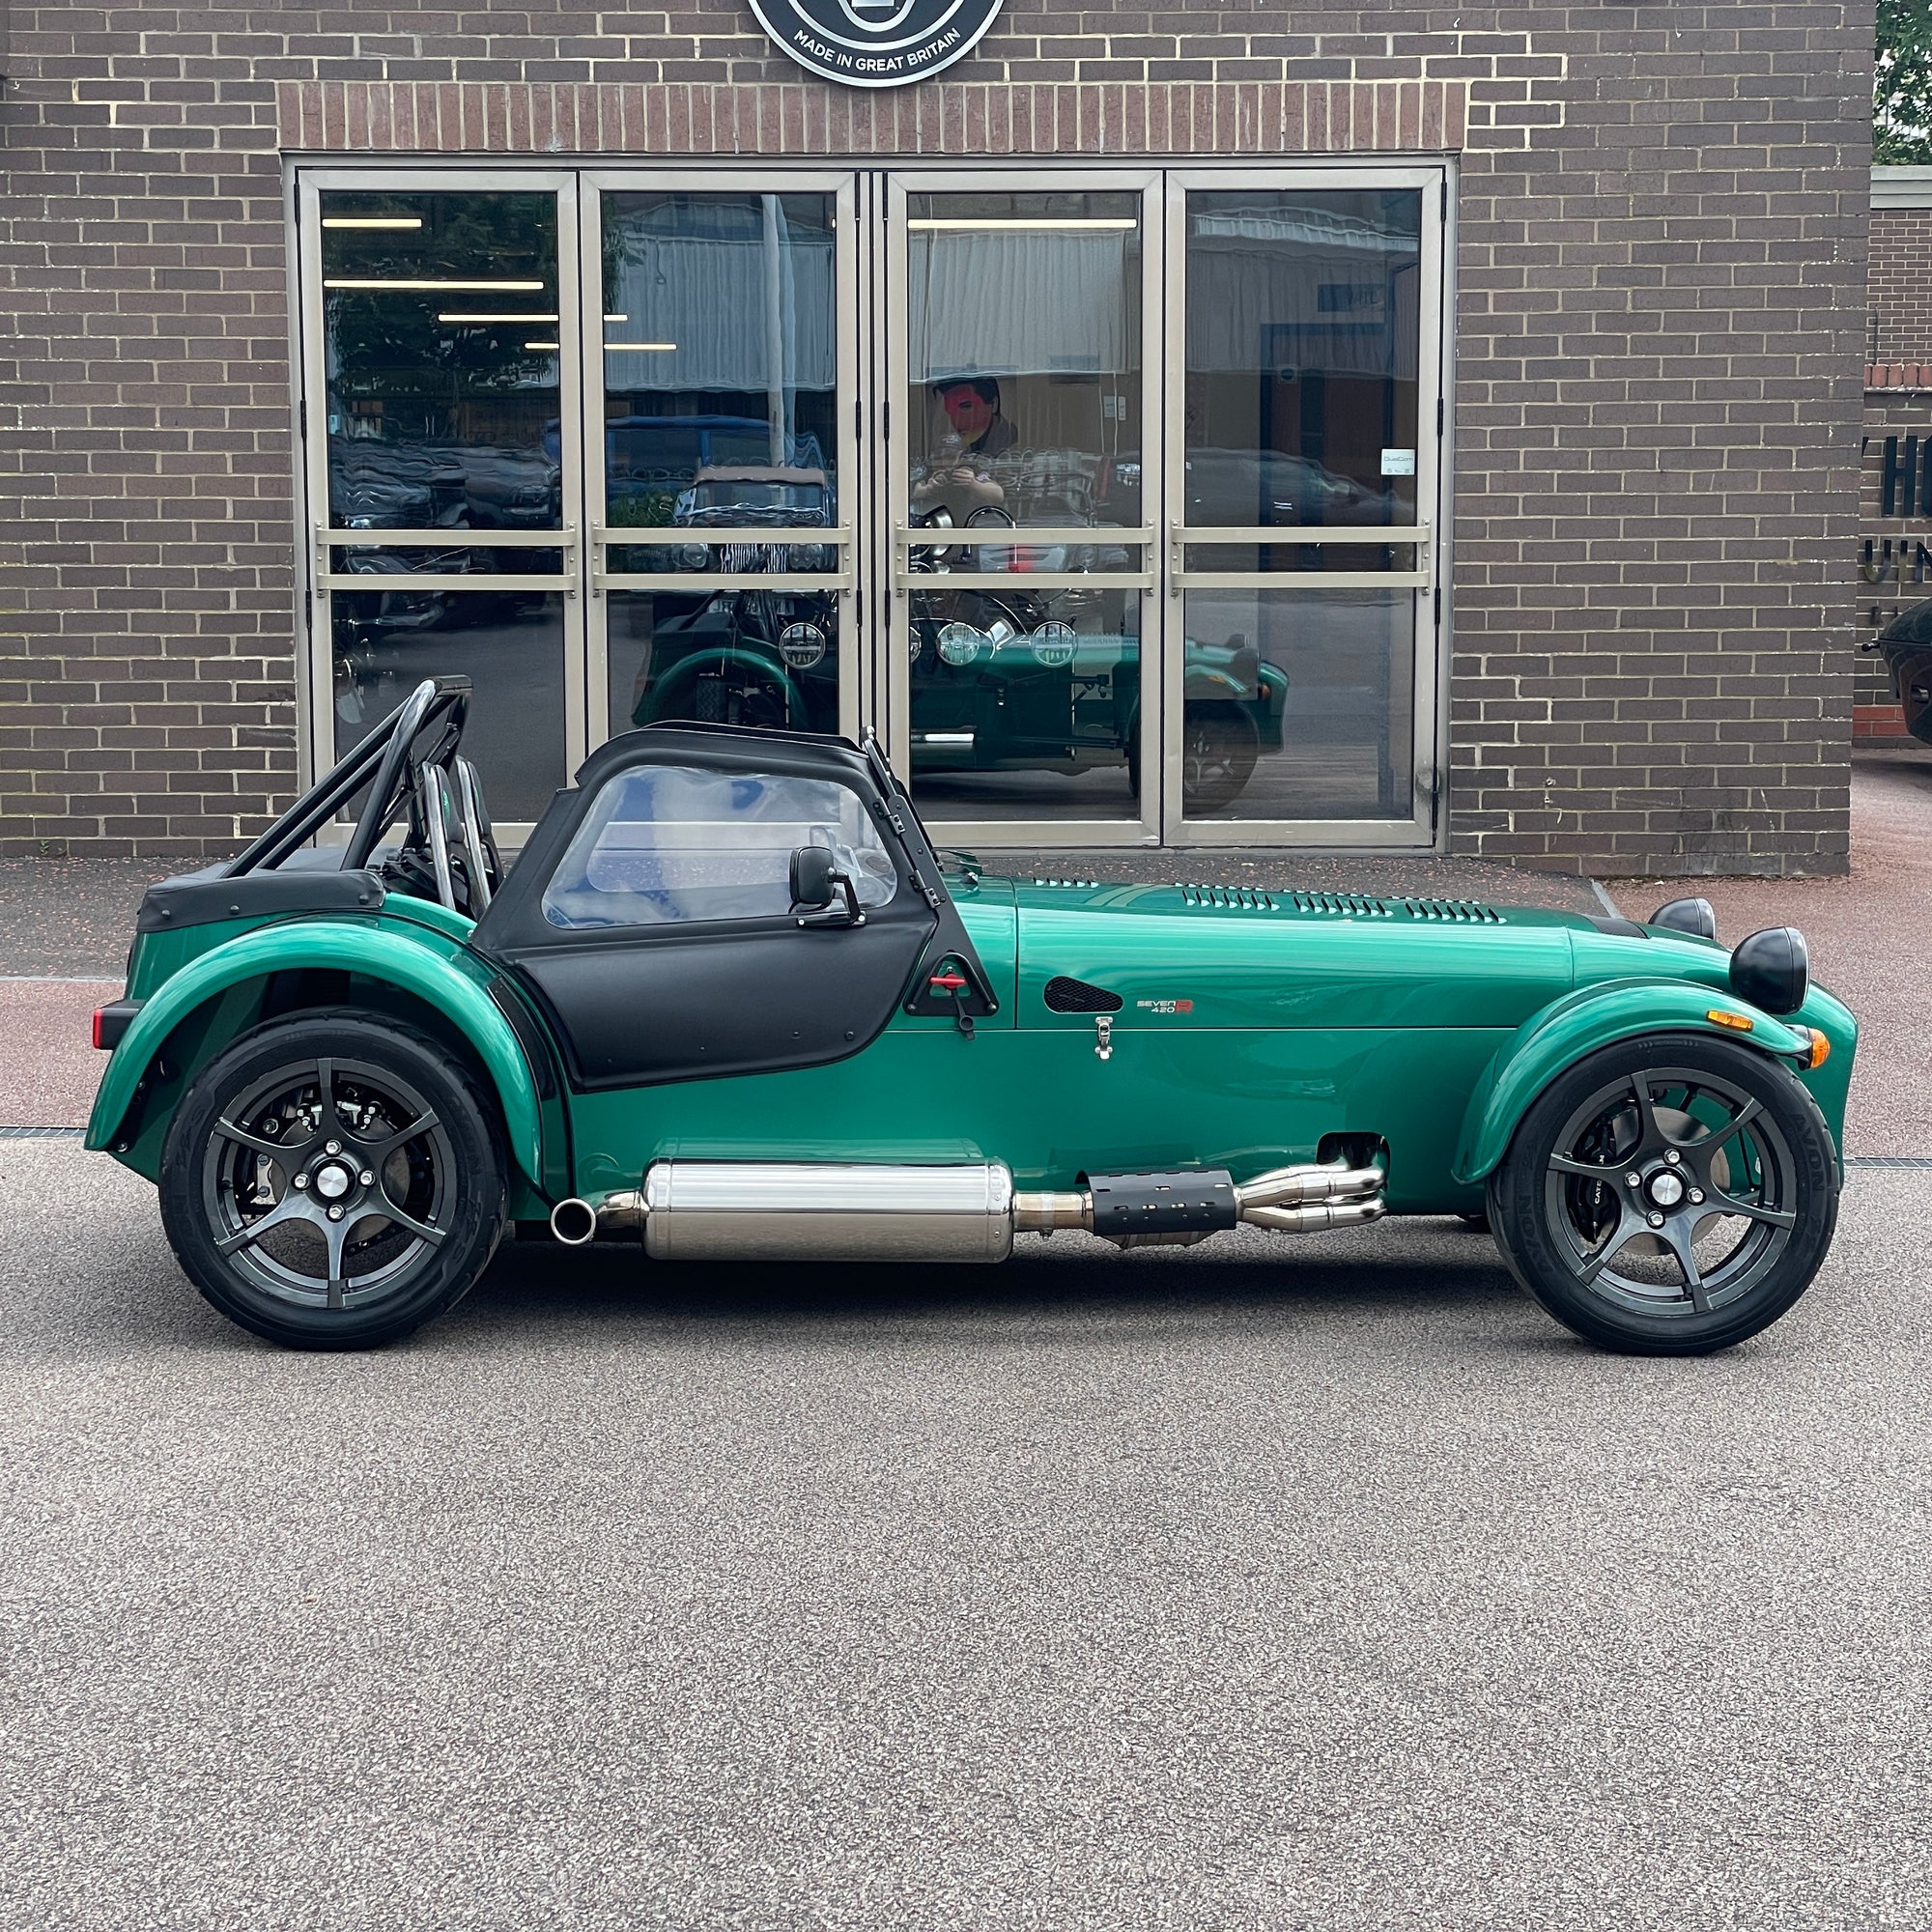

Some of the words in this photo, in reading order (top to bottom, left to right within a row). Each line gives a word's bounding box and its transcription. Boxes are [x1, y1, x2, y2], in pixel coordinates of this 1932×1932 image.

[793, 29, 834, 62] MADE
[837, 53, 852, 69] IN
[855, 56, 903, 71] GREAT
[906, 27, 961, 67] BRITAIN
[1789, 1112, 1825, 1192] AVON
